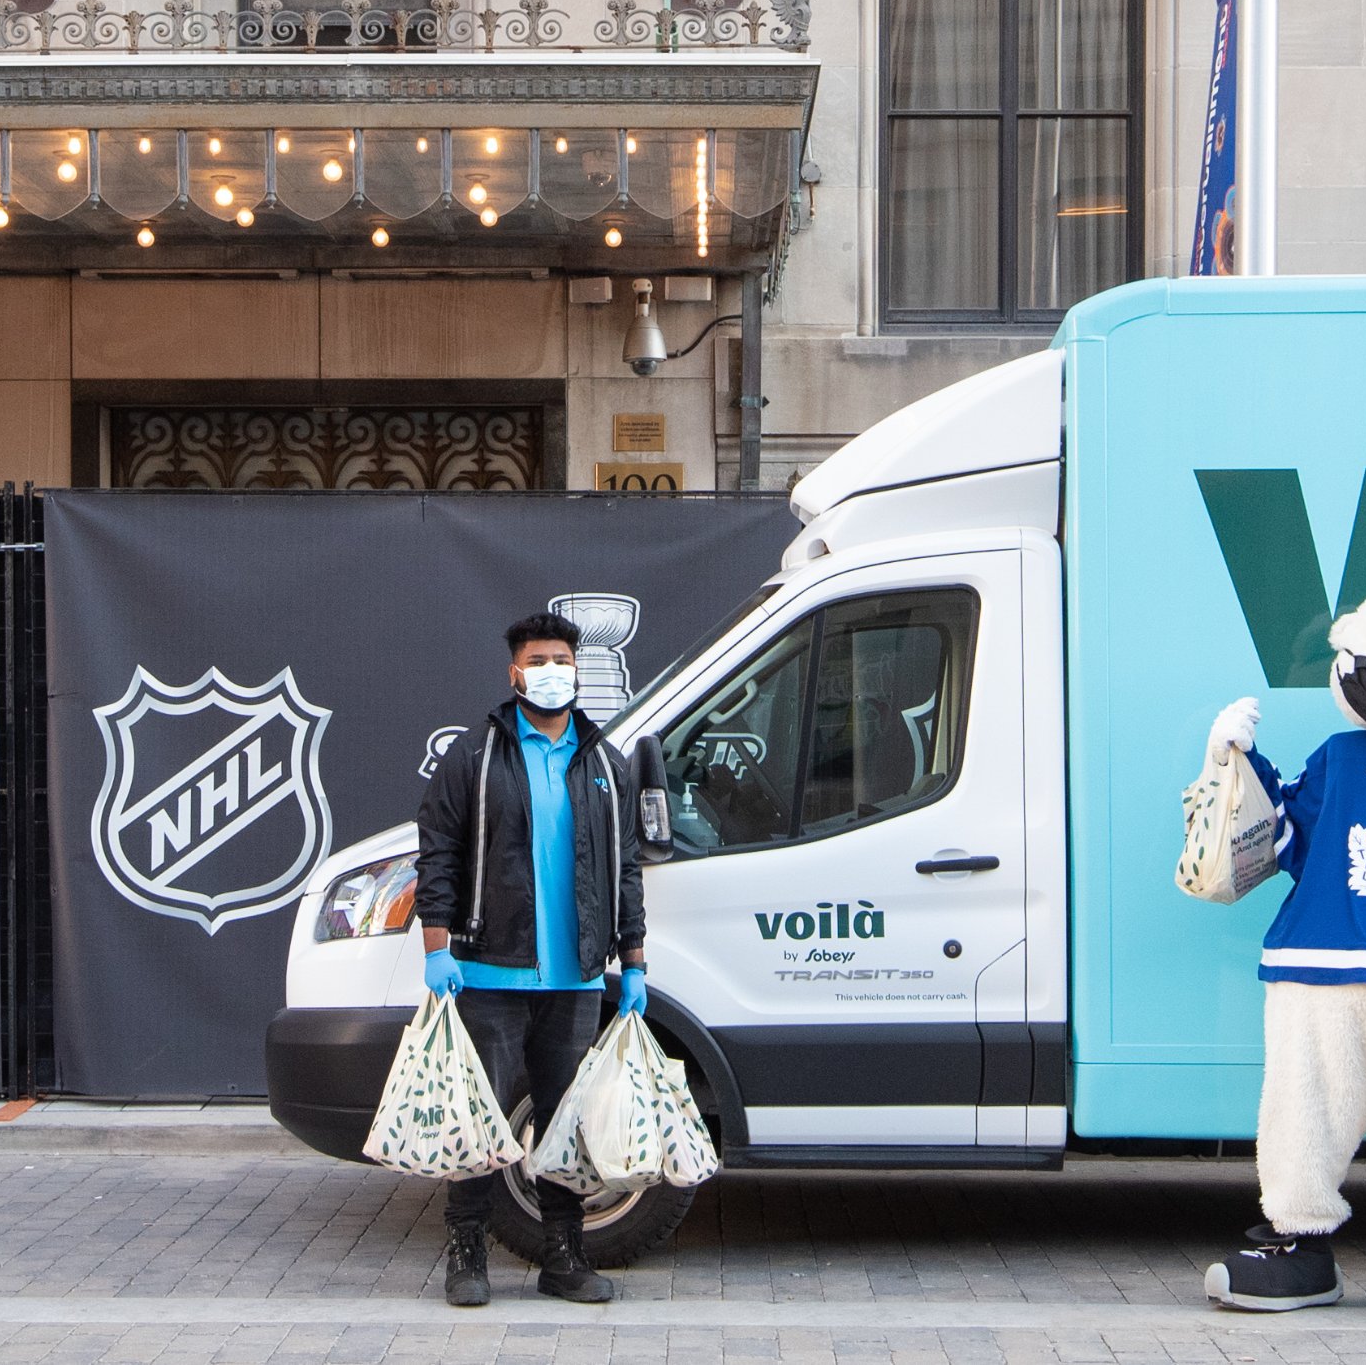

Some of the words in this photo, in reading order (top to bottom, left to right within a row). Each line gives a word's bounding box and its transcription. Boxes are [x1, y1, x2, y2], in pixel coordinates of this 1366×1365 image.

[146, 735, 283, 872] NHL
[754, 899, 885, 940] voilà
[783, 950, 799, 963] by
[804, 948, 856, 964] Sobeys
[835, 993, 853, 1001] This
[854, 993, 884, 1001] vehicle
[885, 993, 906, 1001] does
[906, 993, 921, 1001] not
[921, 993, 945, 1002] carry
[946, 992, 968, 1001] cash.
